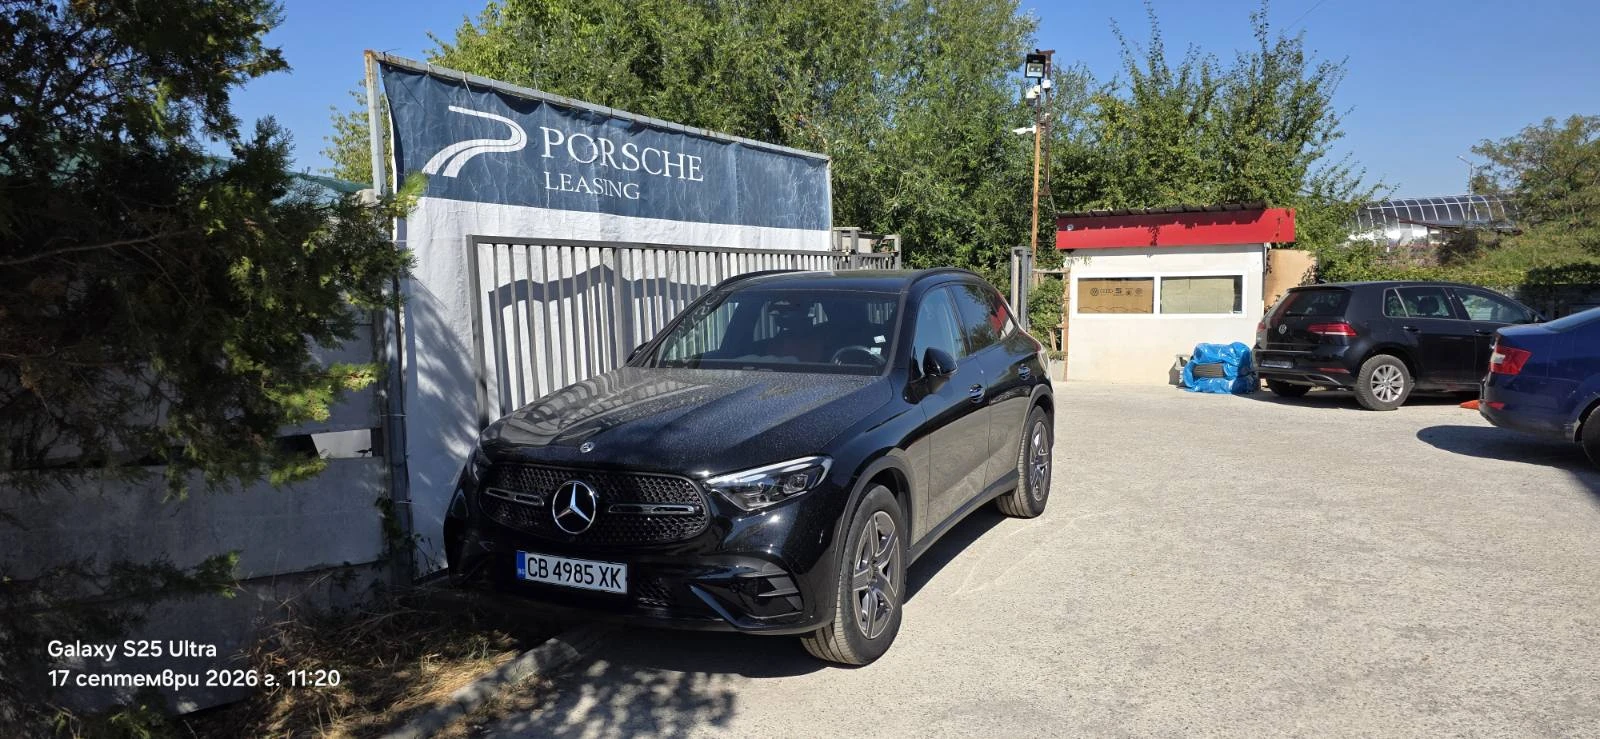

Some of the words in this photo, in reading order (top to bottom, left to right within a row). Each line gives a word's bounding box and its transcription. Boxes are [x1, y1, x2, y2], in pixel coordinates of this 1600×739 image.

[539, 126, 704, 182] PORSCHE
[543, 171, 640, 200] LEASING
[527, 557, 549, 579] CB
[552, 560, 594, 585] 4985
[598, 565, 622, 589] XK
